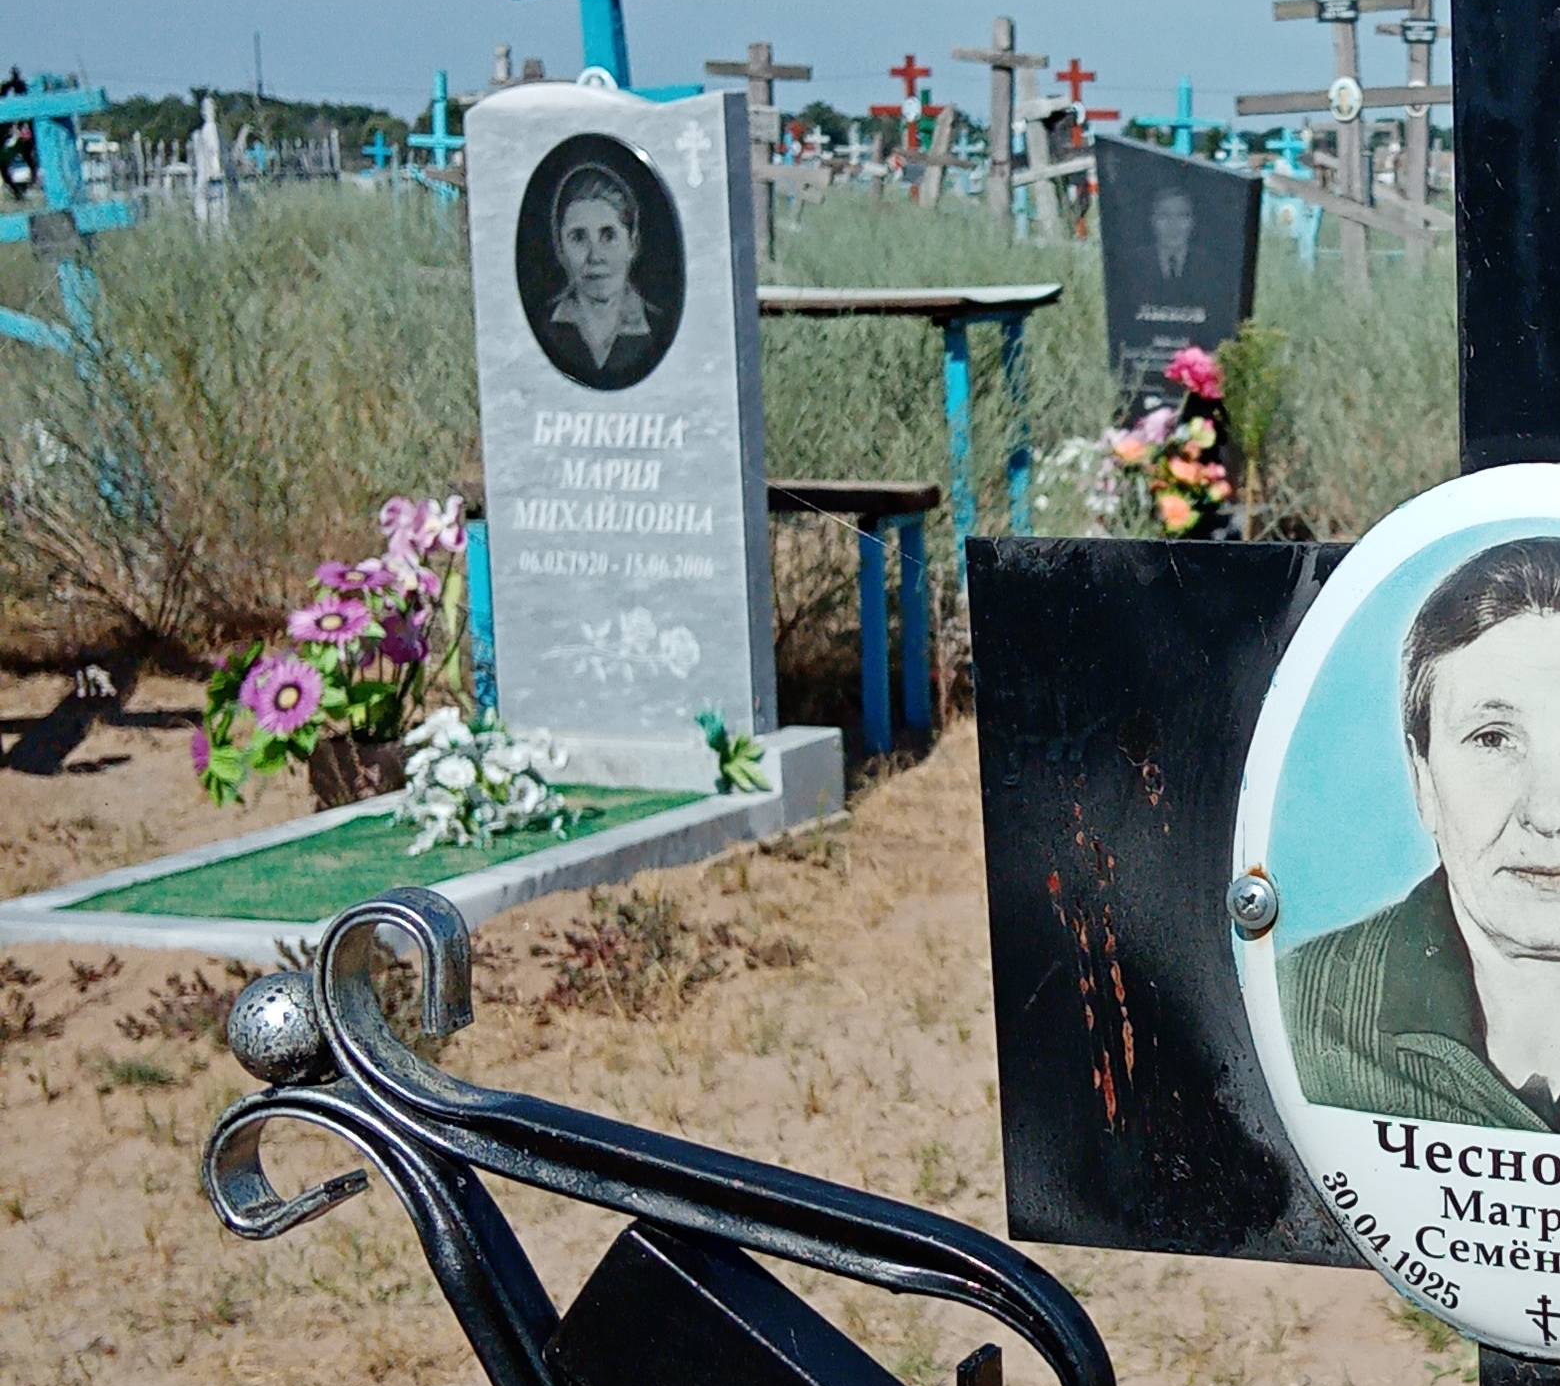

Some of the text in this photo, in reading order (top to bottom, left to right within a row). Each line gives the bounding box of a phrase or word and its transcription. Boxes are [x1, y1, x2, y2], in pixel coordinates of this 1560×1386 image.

[532, 411, 688, 449] БРЯКИНА
[559, 458, 661, 490] МАРИЯ
[511, 494, 714, 535] МИХАЙЛОВНА
[1321, 1170, 1461, 1310] 30.04.1925
